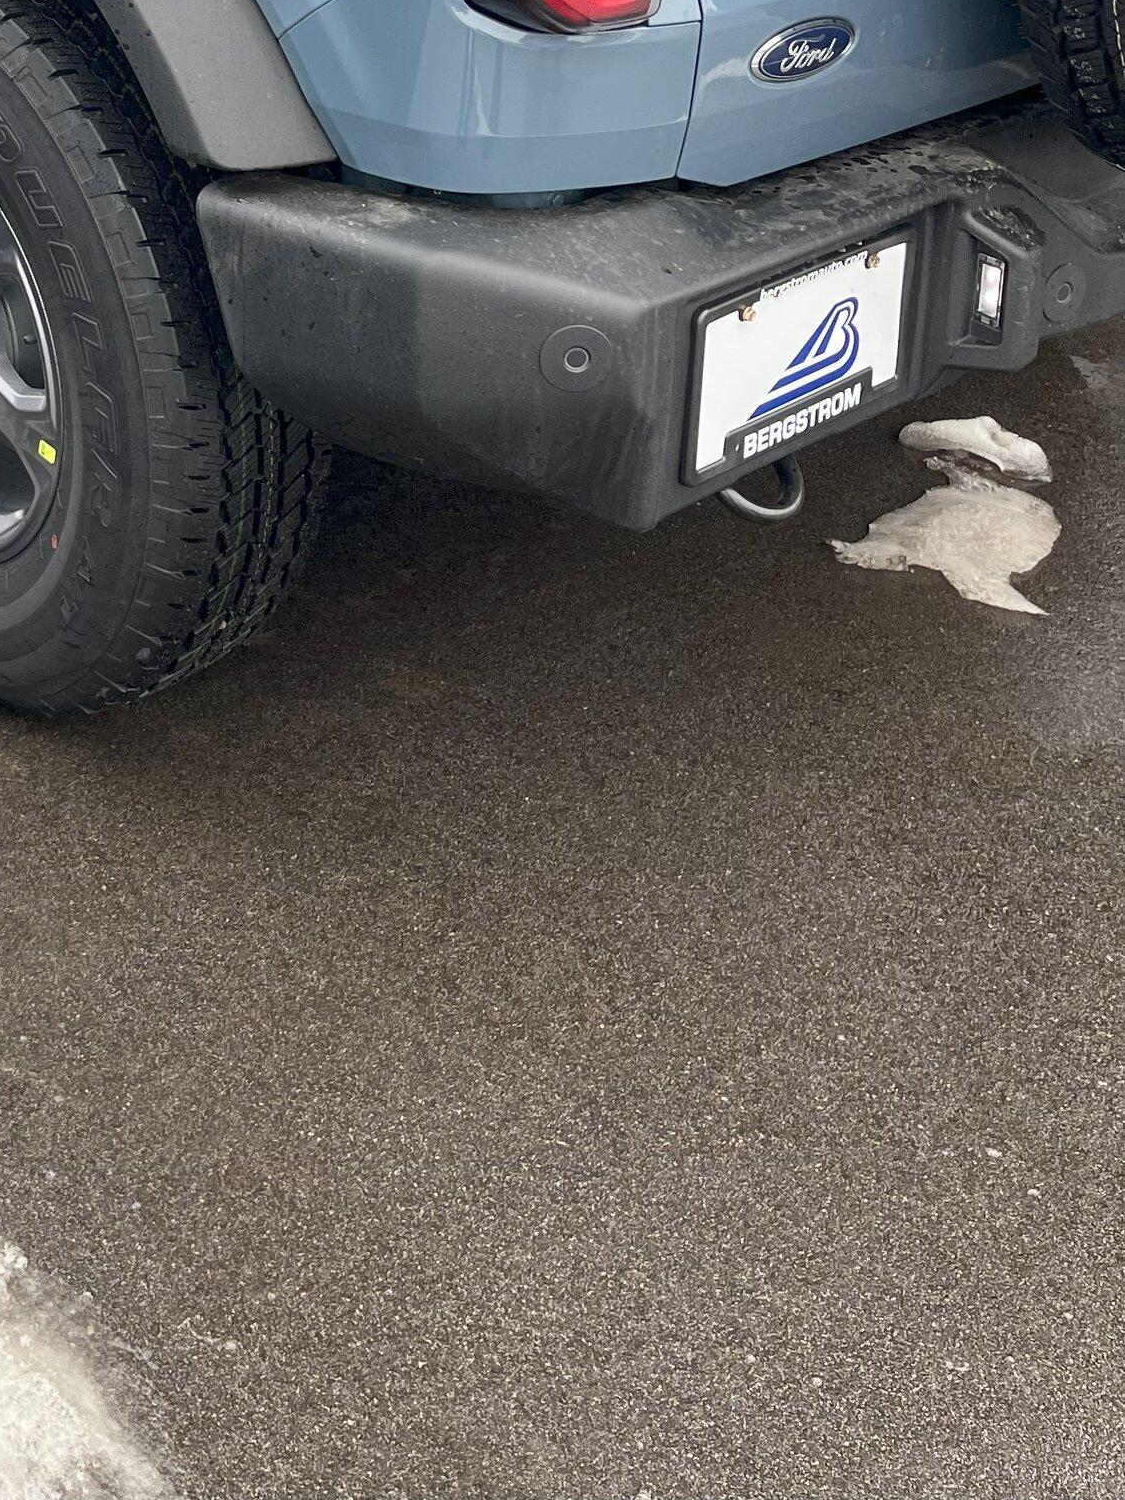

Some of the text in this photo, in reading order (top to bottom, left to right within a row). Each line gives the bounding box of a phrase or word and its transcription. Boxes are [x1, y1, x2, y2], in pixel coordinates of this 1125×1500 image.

[779, 33, 837, 73] Ford
[759, 250, 869, 301] bergstromauto.com
[743, 382, 862, 459] BERGSTROM
